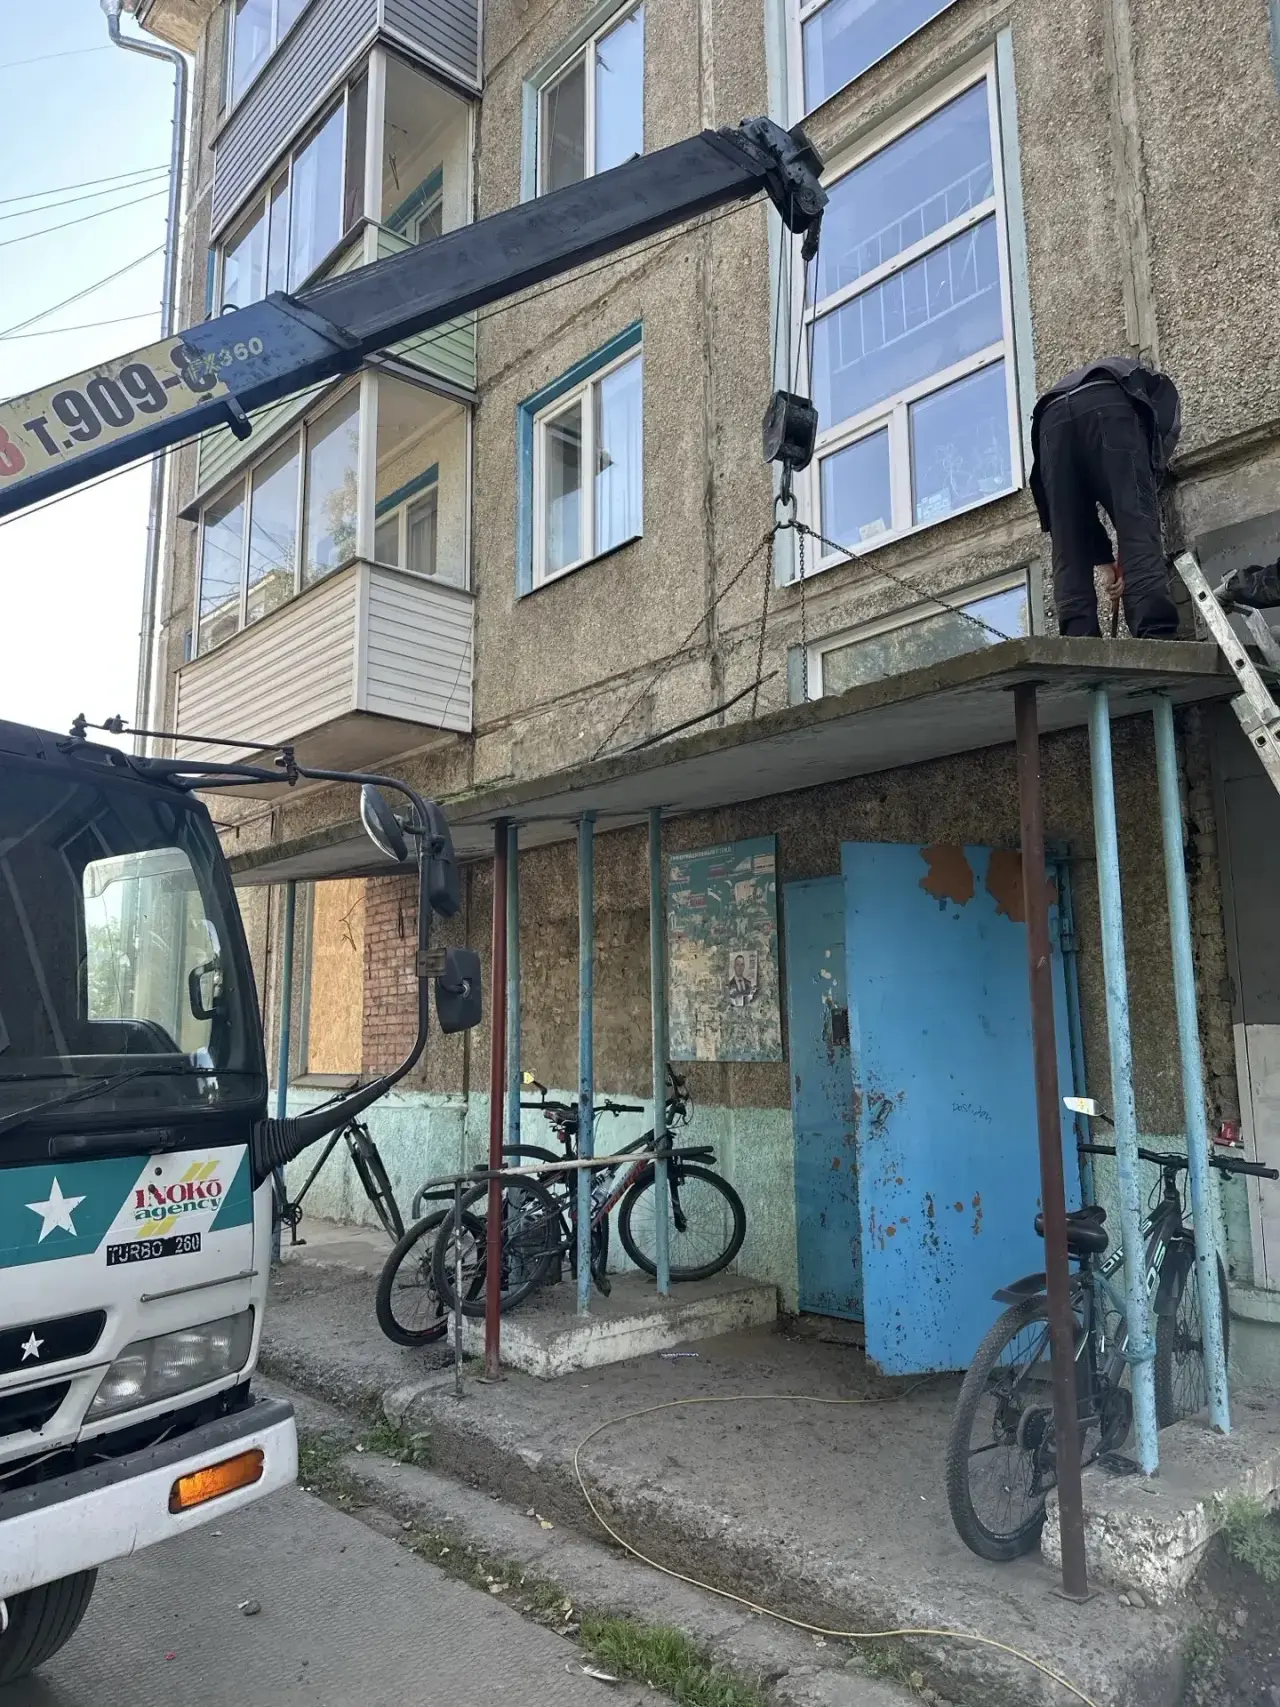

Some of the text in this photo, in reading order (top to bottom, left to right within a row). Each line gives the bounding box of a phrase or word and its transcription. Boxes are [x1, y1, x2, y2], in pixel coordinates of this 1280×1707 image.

[134, 1197, 222, 1221] agency
[108, 1235, 200, 1263] TURBO 260
